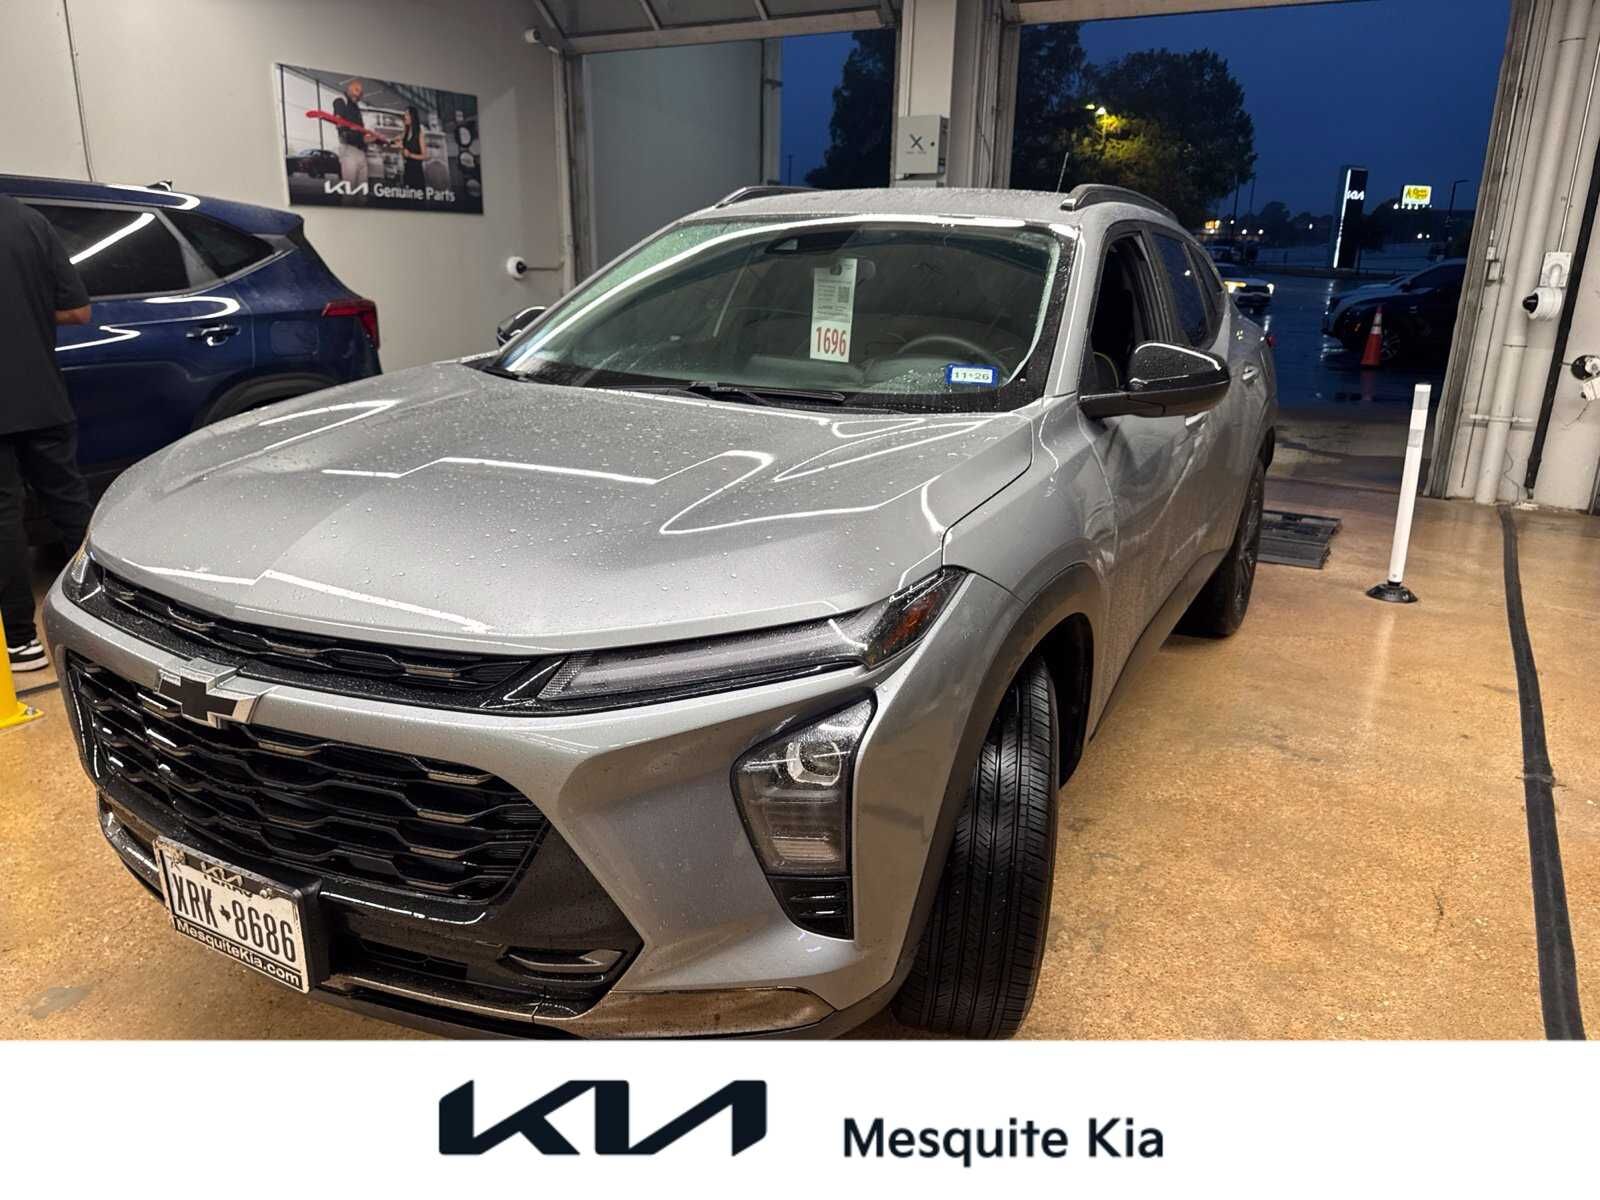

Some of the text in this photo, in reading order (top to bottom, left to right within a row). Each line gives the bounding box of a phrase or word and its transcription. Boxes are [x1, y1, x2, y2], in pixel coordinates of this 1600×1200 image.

[324, 180, 456, 202] KIA Genuine Parts
[815, 326, 848, 357] 1696
[172, 873, 218, 929] XRK
[231, 899, 296, 963] 8686
[176, 920, 301, 986] MesquiteKia.com
